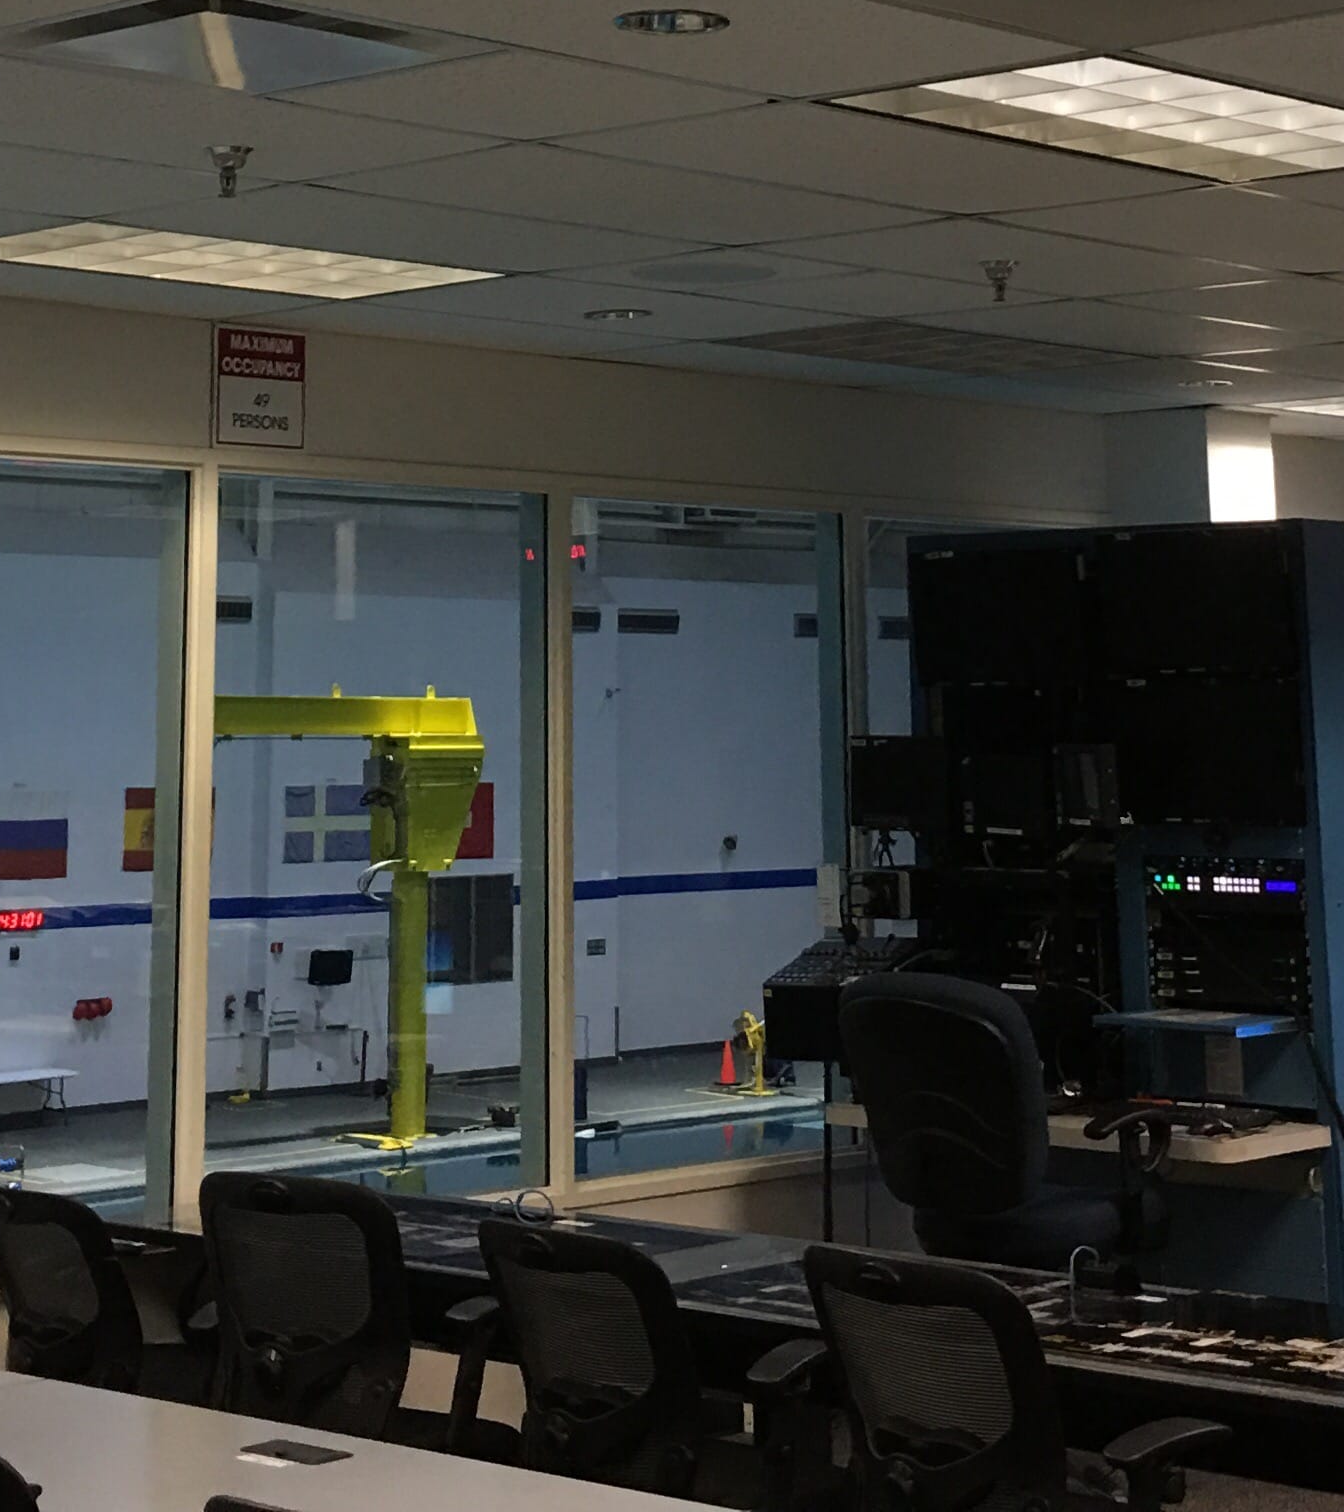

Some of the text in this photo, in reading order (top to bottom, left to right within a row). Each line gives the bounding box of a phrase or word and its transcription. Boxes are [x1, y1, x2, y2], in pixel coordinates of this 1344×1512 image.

[230, 333, 295, 355] MAXIMUM
[221, 356, 302, 378] OCCUPANCY
[253, 393, 271, 408] 49
[231, 412, 289, 432] PERSONS
